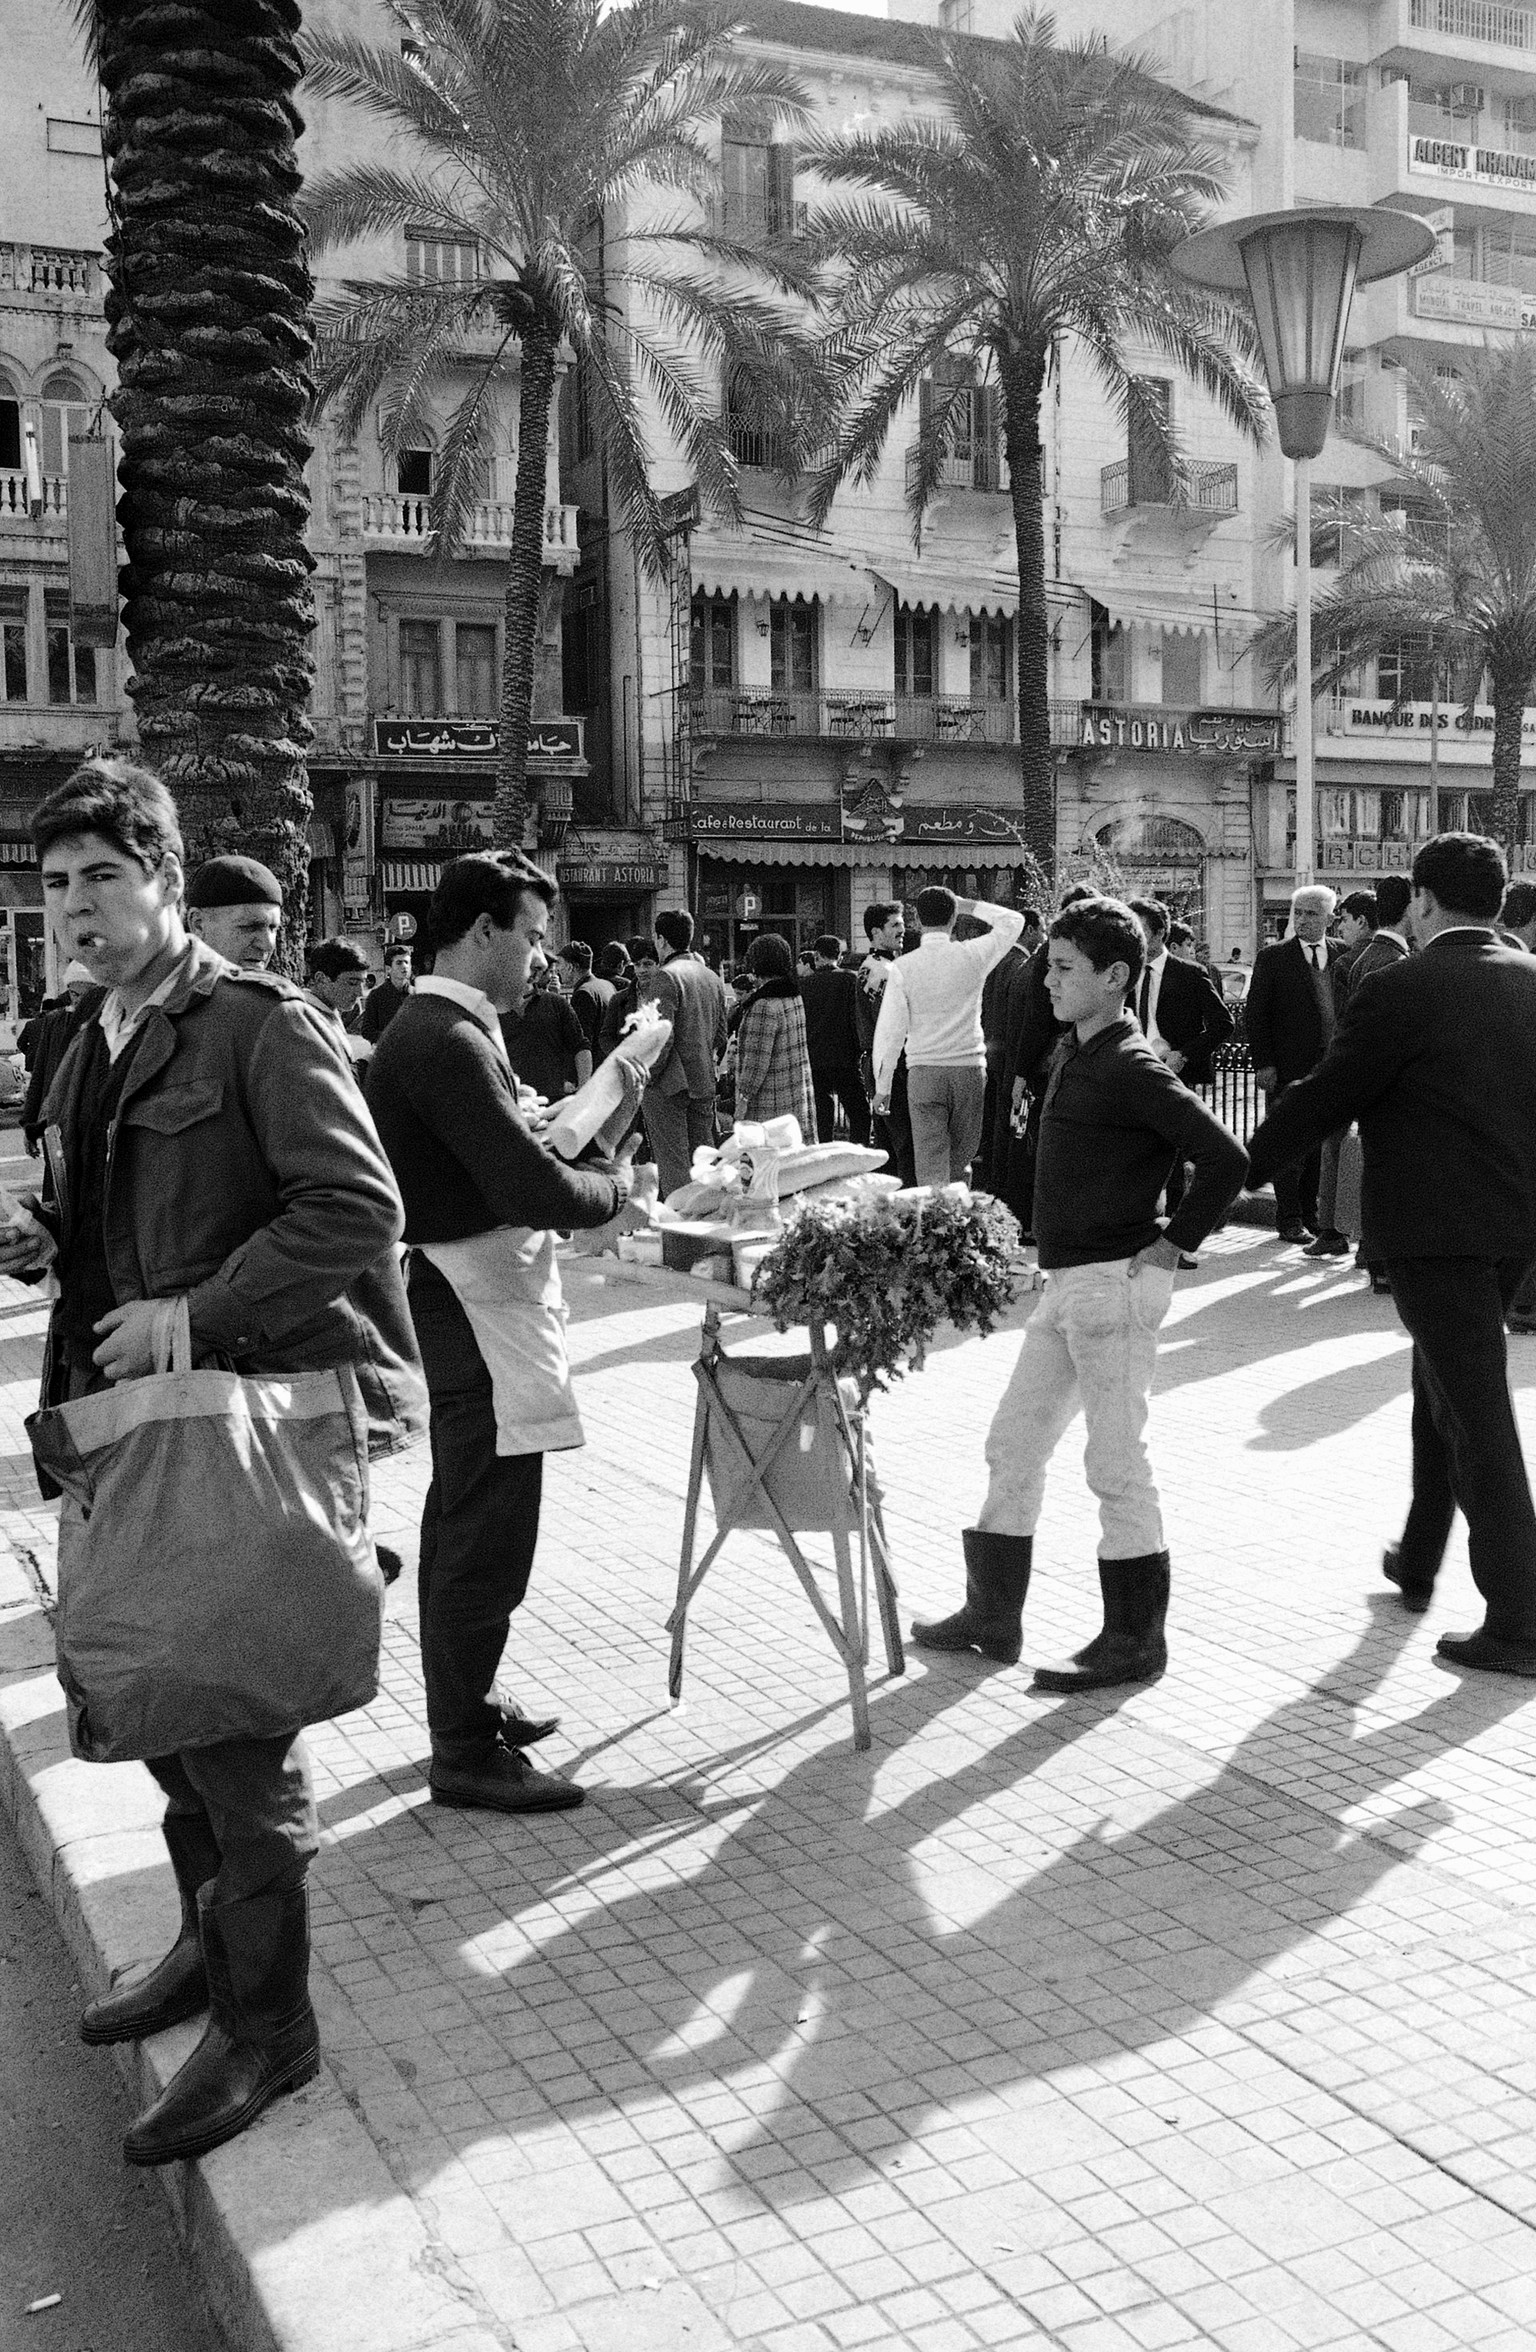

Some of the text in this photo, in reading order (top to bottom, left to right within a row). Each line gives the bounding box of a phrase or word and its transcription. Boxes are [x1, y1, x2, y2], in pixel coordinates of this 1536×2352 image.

[1414, 138, 1470, 170] ALBERT
[1352, 709, 1414, 728] BANQUE
[388, 729, 456, 755] شهاب
[1083, 717, 1186, 749] ASTORIA
[805, 822, 817, 832] de
[821, 822, 831, 832] la
[613, 866, 655, 883] ASTORIA
[745, 896, 756, 918] P
[398, 915, 410, 936] P
